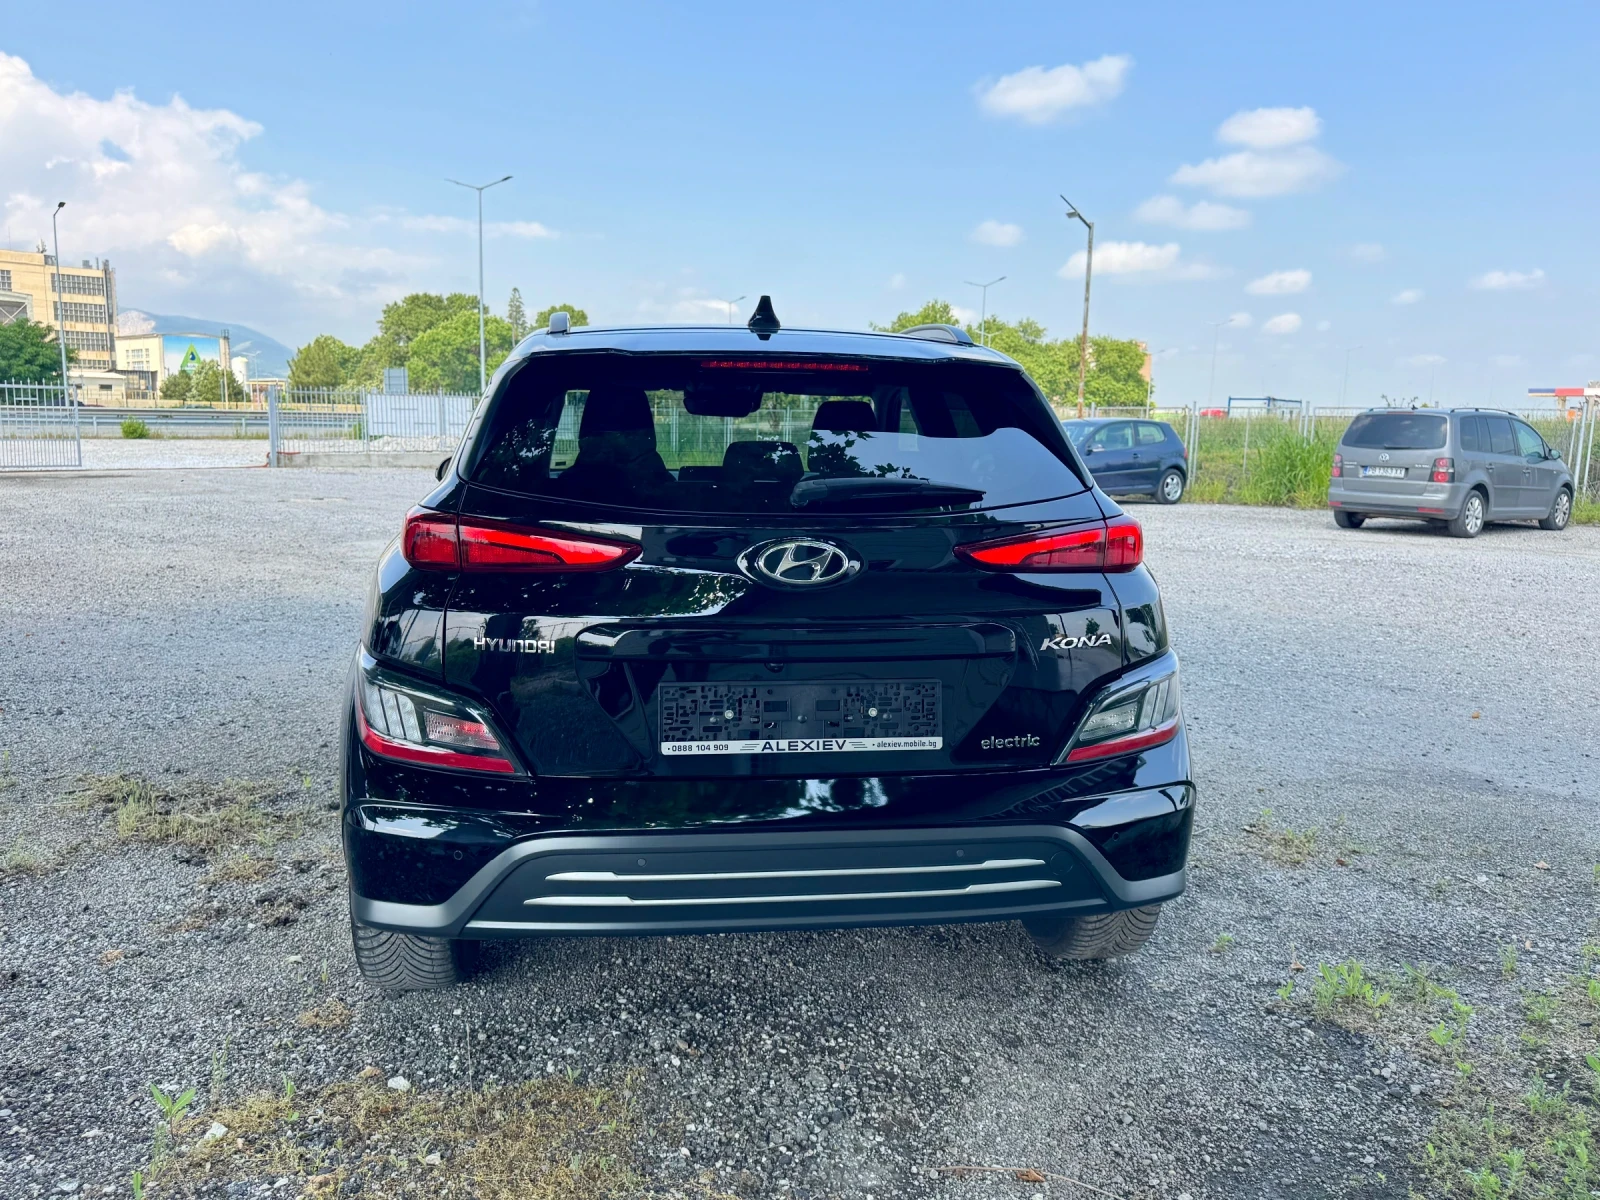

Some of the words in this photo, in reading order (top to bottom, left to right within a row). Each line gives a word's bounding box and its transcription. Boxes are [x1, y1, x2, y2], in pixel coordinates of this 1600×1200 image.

[473, 636, 556, 654] HYUNDAI
[1040, 633, 1112, 651] KONA
[671, 744, 693, 752] 0888
[695, 744, 711, 752] 104
[713, 743, 729, 751] 909
[761, 739, 847, 752] ALEXIEV
[981, 733, 1041, 750] electric
